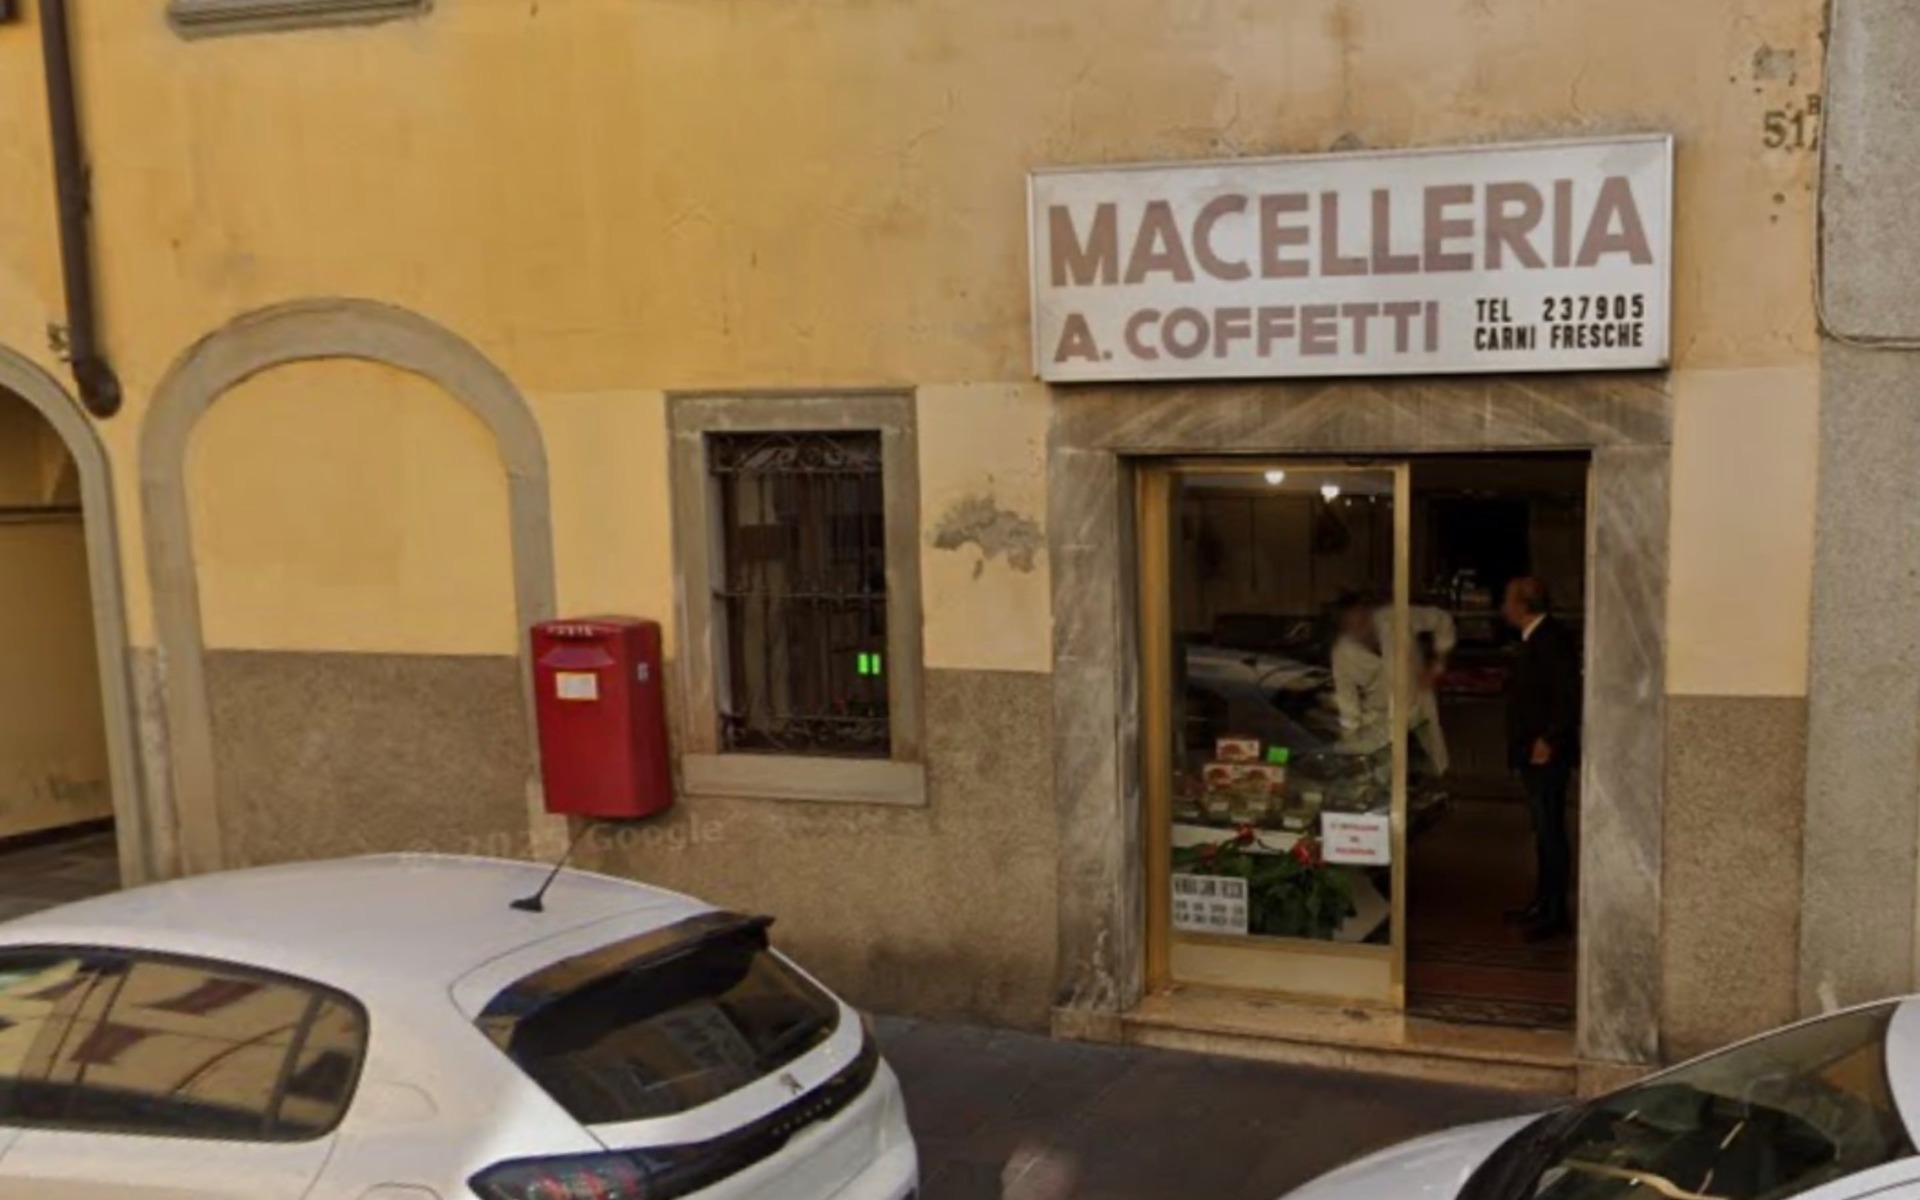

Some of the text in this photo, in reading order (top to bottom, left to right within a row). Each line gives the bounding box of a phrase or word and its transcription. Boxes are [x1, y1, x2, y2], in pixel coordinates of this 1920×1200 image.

[1049, 176, 1653, 287] MACELLERIA
[1475, 294, 1644, 322] TEL 237905
[1054, 301, 1439, 362] A. COFFETTI
[1474, 323, 1643, 350] CARNI FRESCHE
